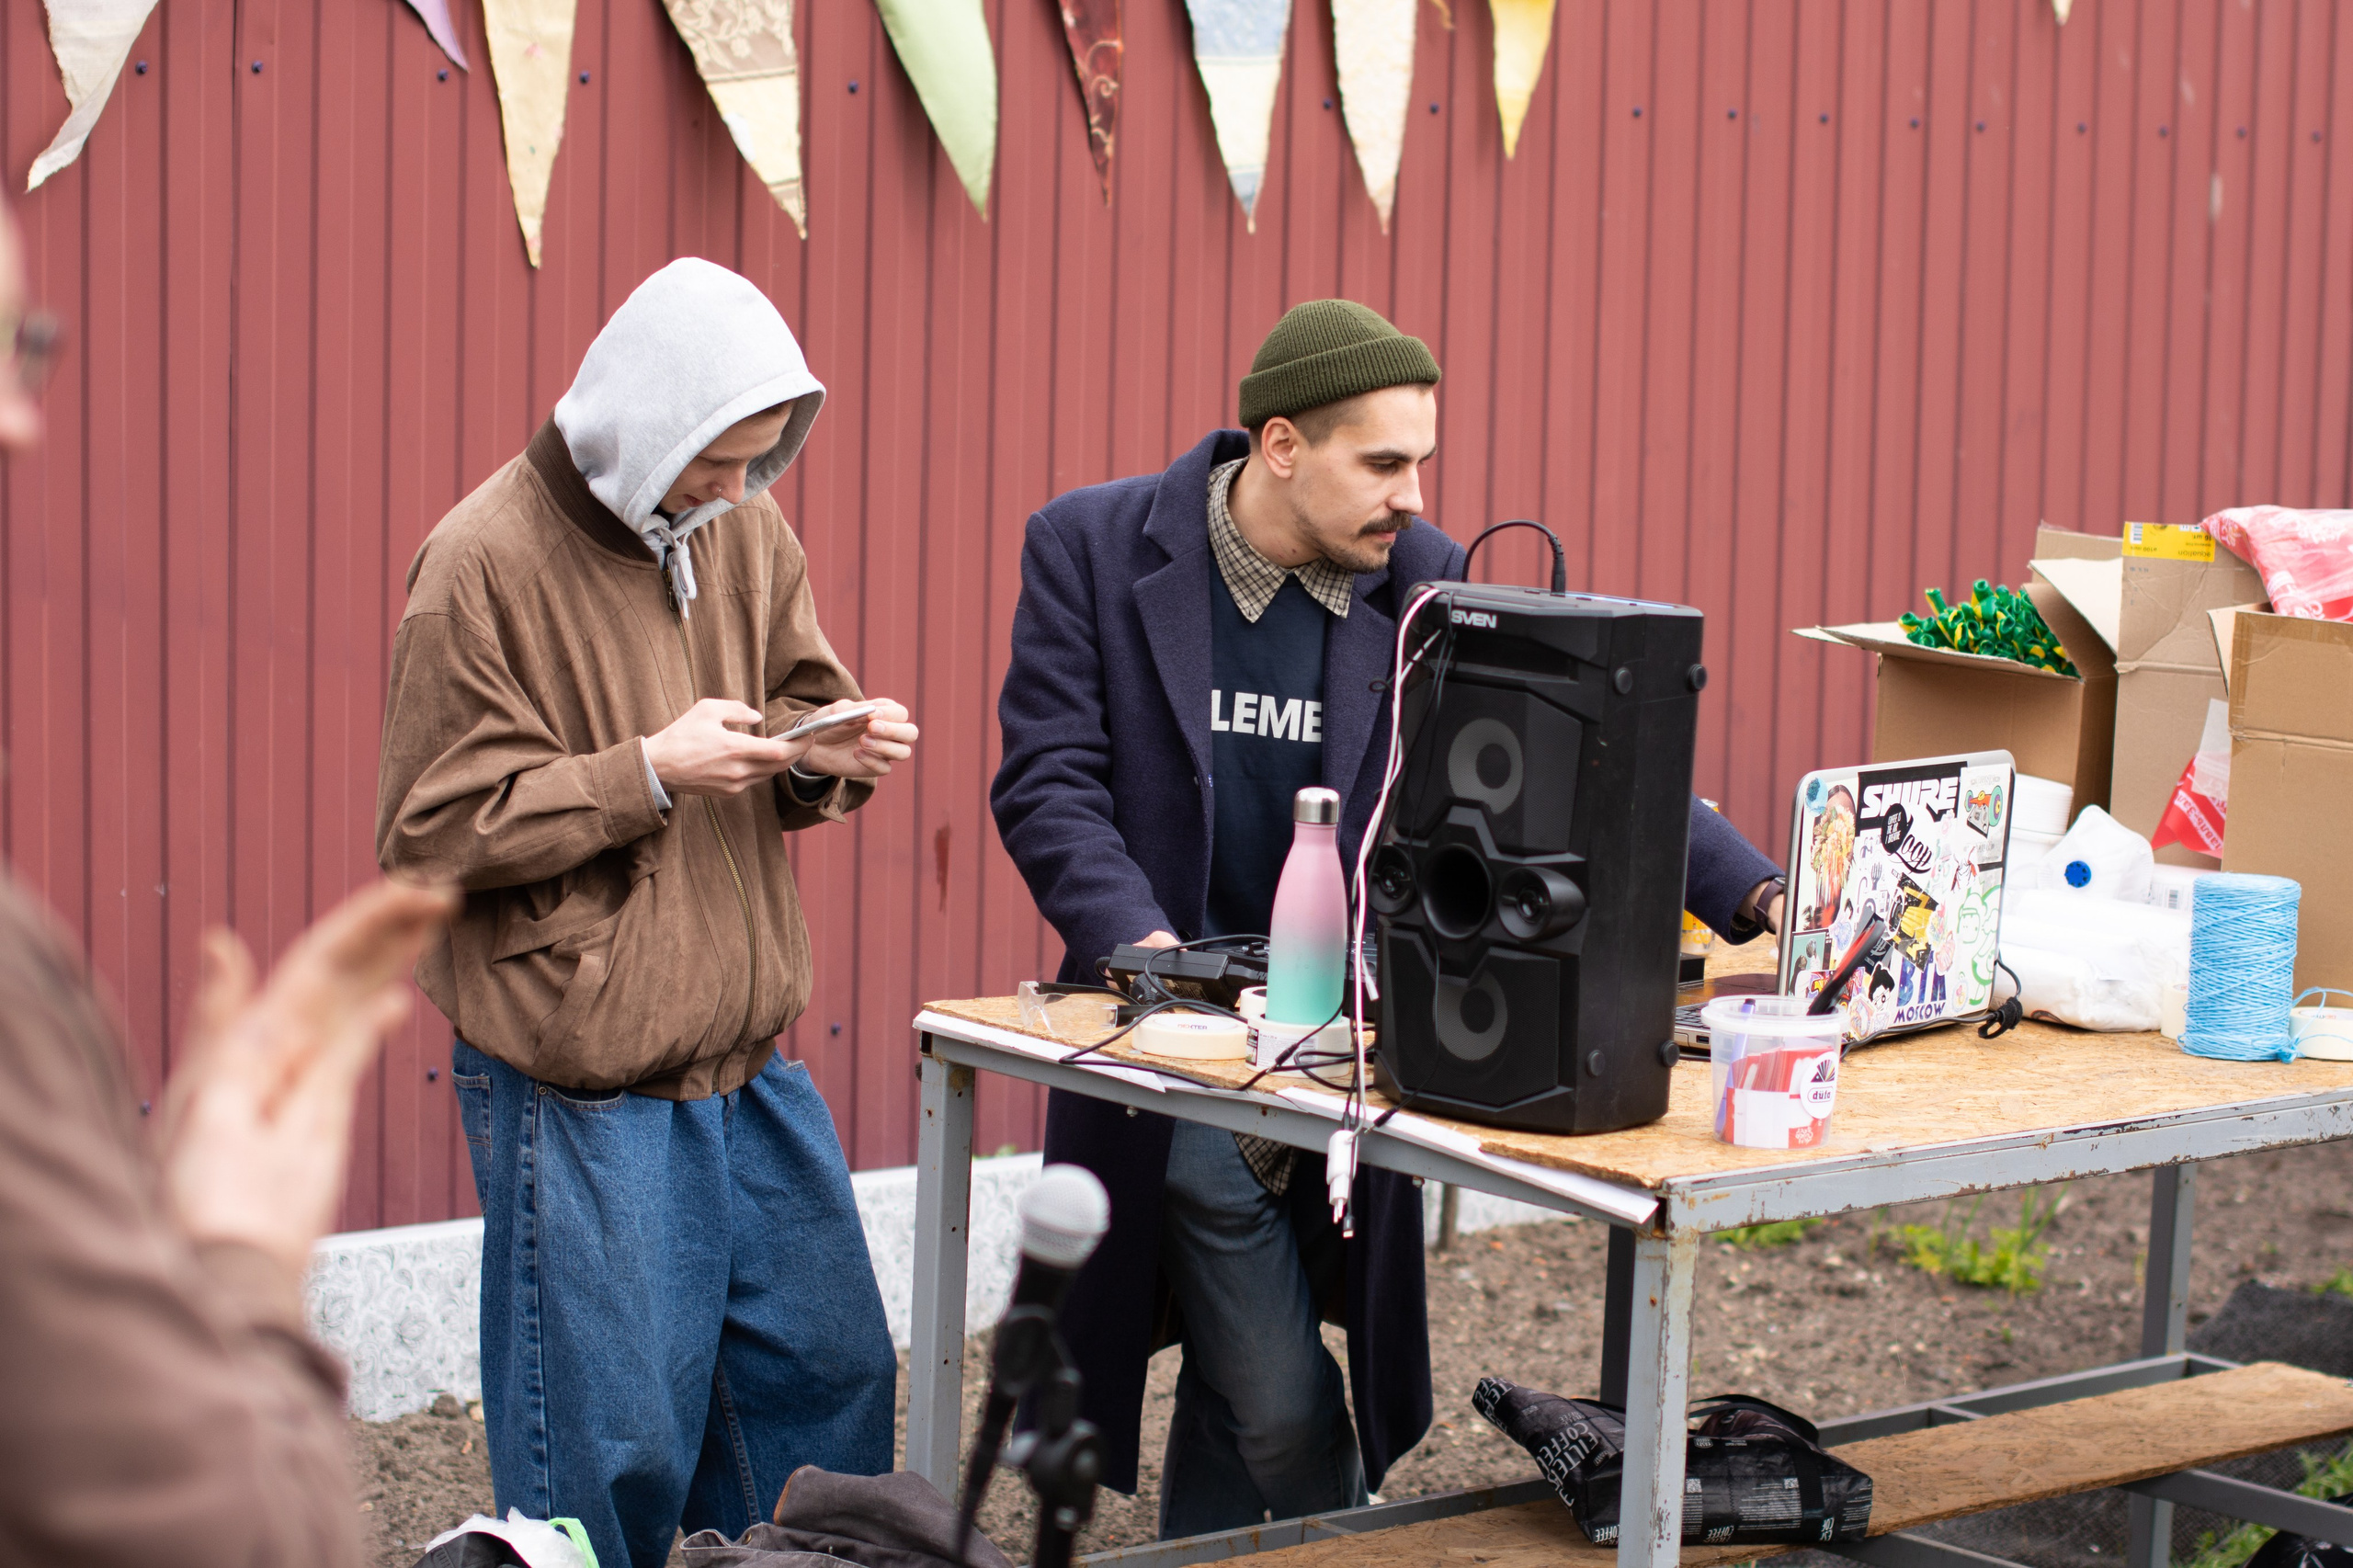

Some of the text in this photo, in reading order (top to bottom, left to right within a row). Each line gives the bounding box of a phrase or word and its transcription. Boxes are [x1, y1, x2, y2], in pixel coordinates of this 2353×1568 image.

[1451, 609, 1496, 629] SVEN
[1859, 776, 1959, 819] SHURE
[1893, 1002, 1946, 1024] MOSCOW
[1547, 1432, 1599, 1491] FILTER
